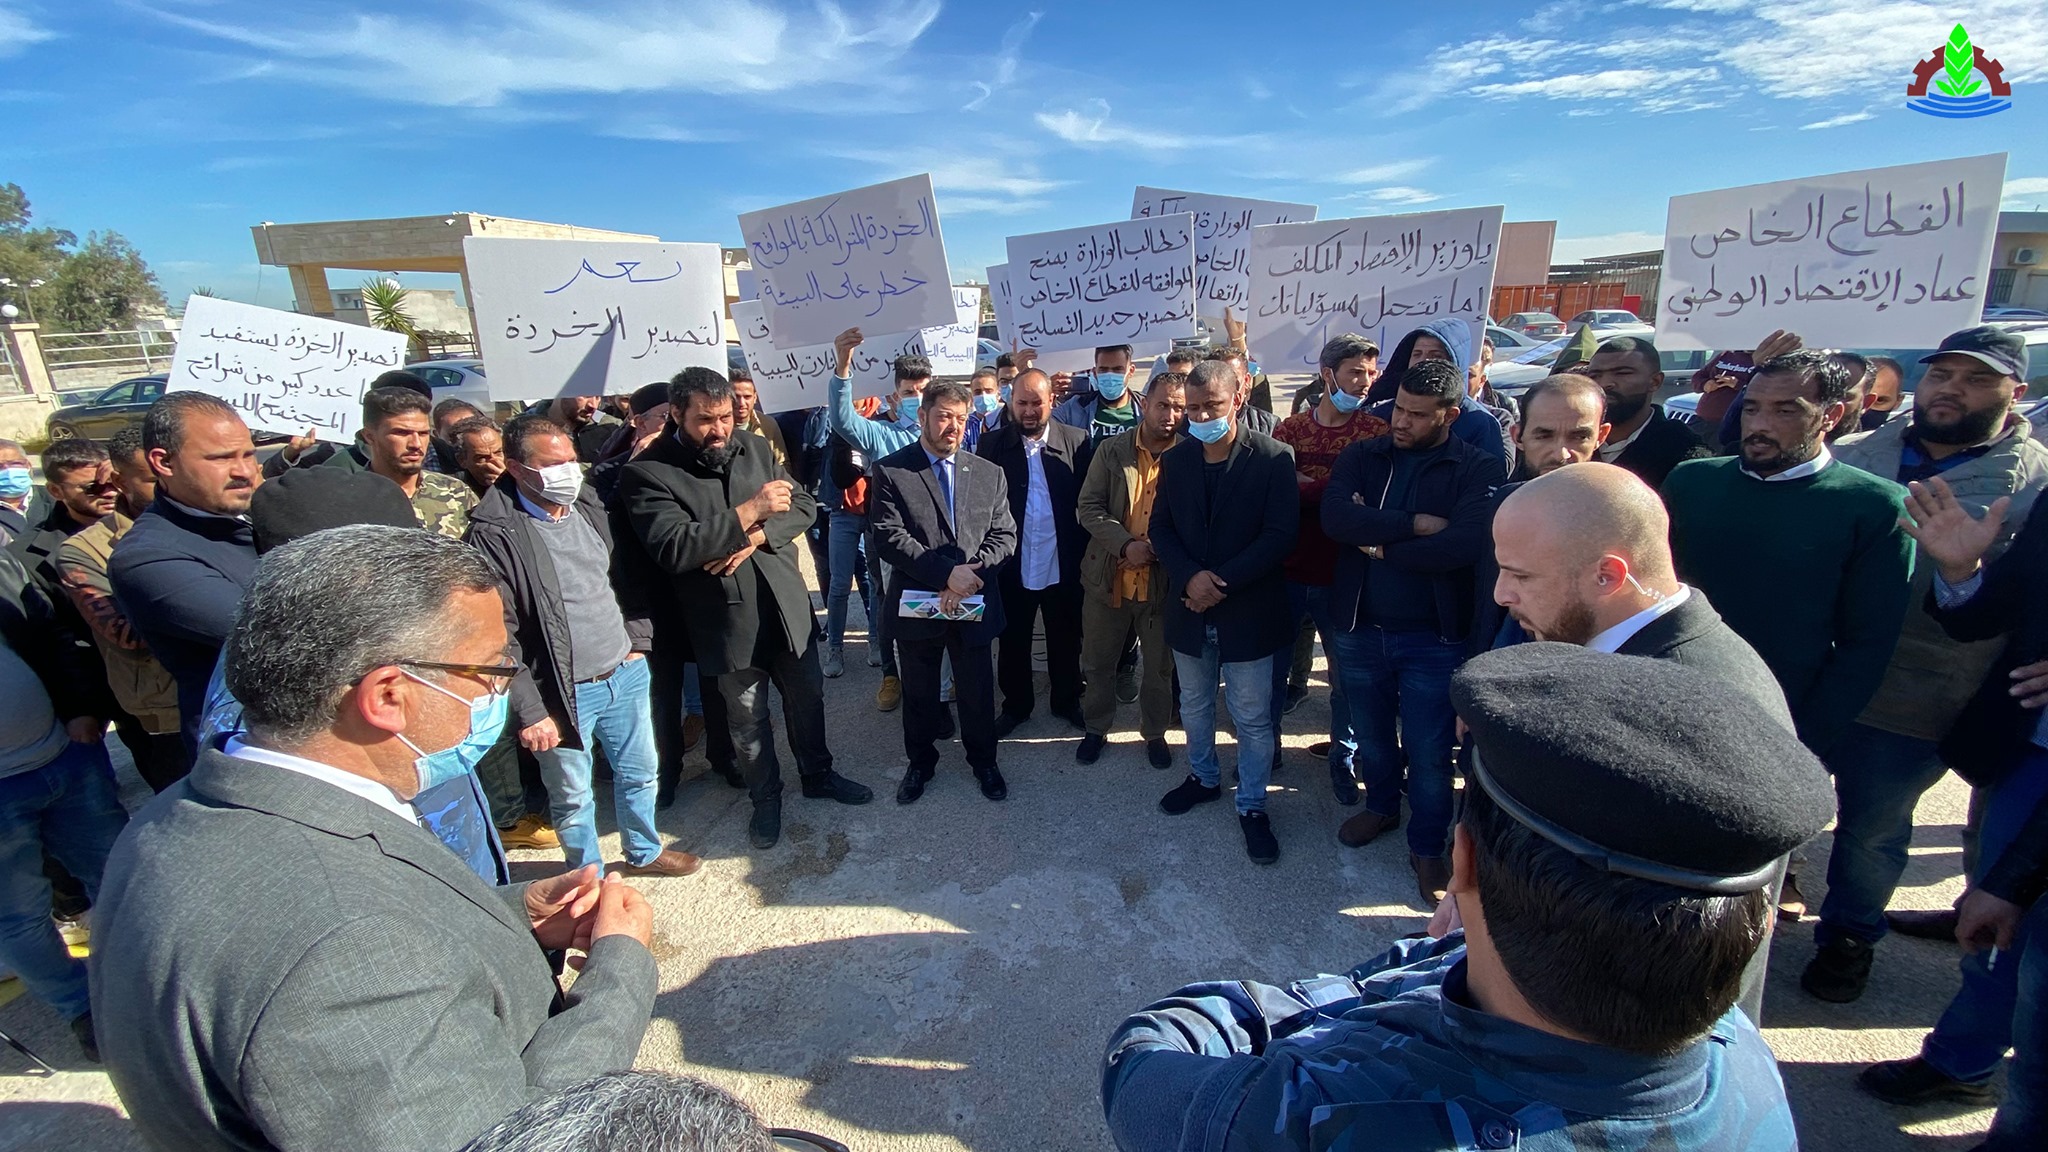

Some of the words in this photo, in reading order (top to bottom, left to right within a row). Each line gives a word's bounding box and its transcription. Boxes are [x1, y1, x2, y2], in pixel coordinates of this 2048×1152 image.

[868, 197, 934, 255] الخردة
[1199, 209, 1253, 239] الوزارة
[1690, 193, 1825, 259] الخاص
[1826, 180, 1965, 257] القطاع
[752, 214, 808, 270] بالمواقع
[1077, 228, 1123, 275] الوزارة
[1124, 227, 1189, 261] نطالب
[1268, 228, 1350, 277] المكلف
[544, 249, 682, 294] نعم
[1029, 249, 1068, 280] بمنح
[1904, 253, 1978, 305] عماد
[764, 270, 822, 310] البيئة
[823, 272, 870, 300] على
[865, 270, 928, 317] خطر
[1020, 275, 1083, 309] الخاص
[1085, 268, 1141, 302] للقطاع
[1449, 277, 1486, 322] إما
[1667, 263, 1768, 323] الوطني
[1774, 264, 1902, 312] الإقتصاد
[1084, 309, 1131, 336] حديد
[1360, 285, 1440, 329] تتحمل
[200, 326, 279, 352] يستفيد
[505, 305, 627, 353] الخردة
[631, 310, 721, 360] لتصدير
[1018, 309, 1084, 348] التسليح
[187, 352, 244, 383] شرائح
[243, 366, 275, 386] من
[334, 346, 399, 372] تصدير
[856, 351, 879, 372] من
[269, 366, 323, 399] كبير
[308, 385, 353, 398] عدد
[258, 401, 346, 434] المجتمع
